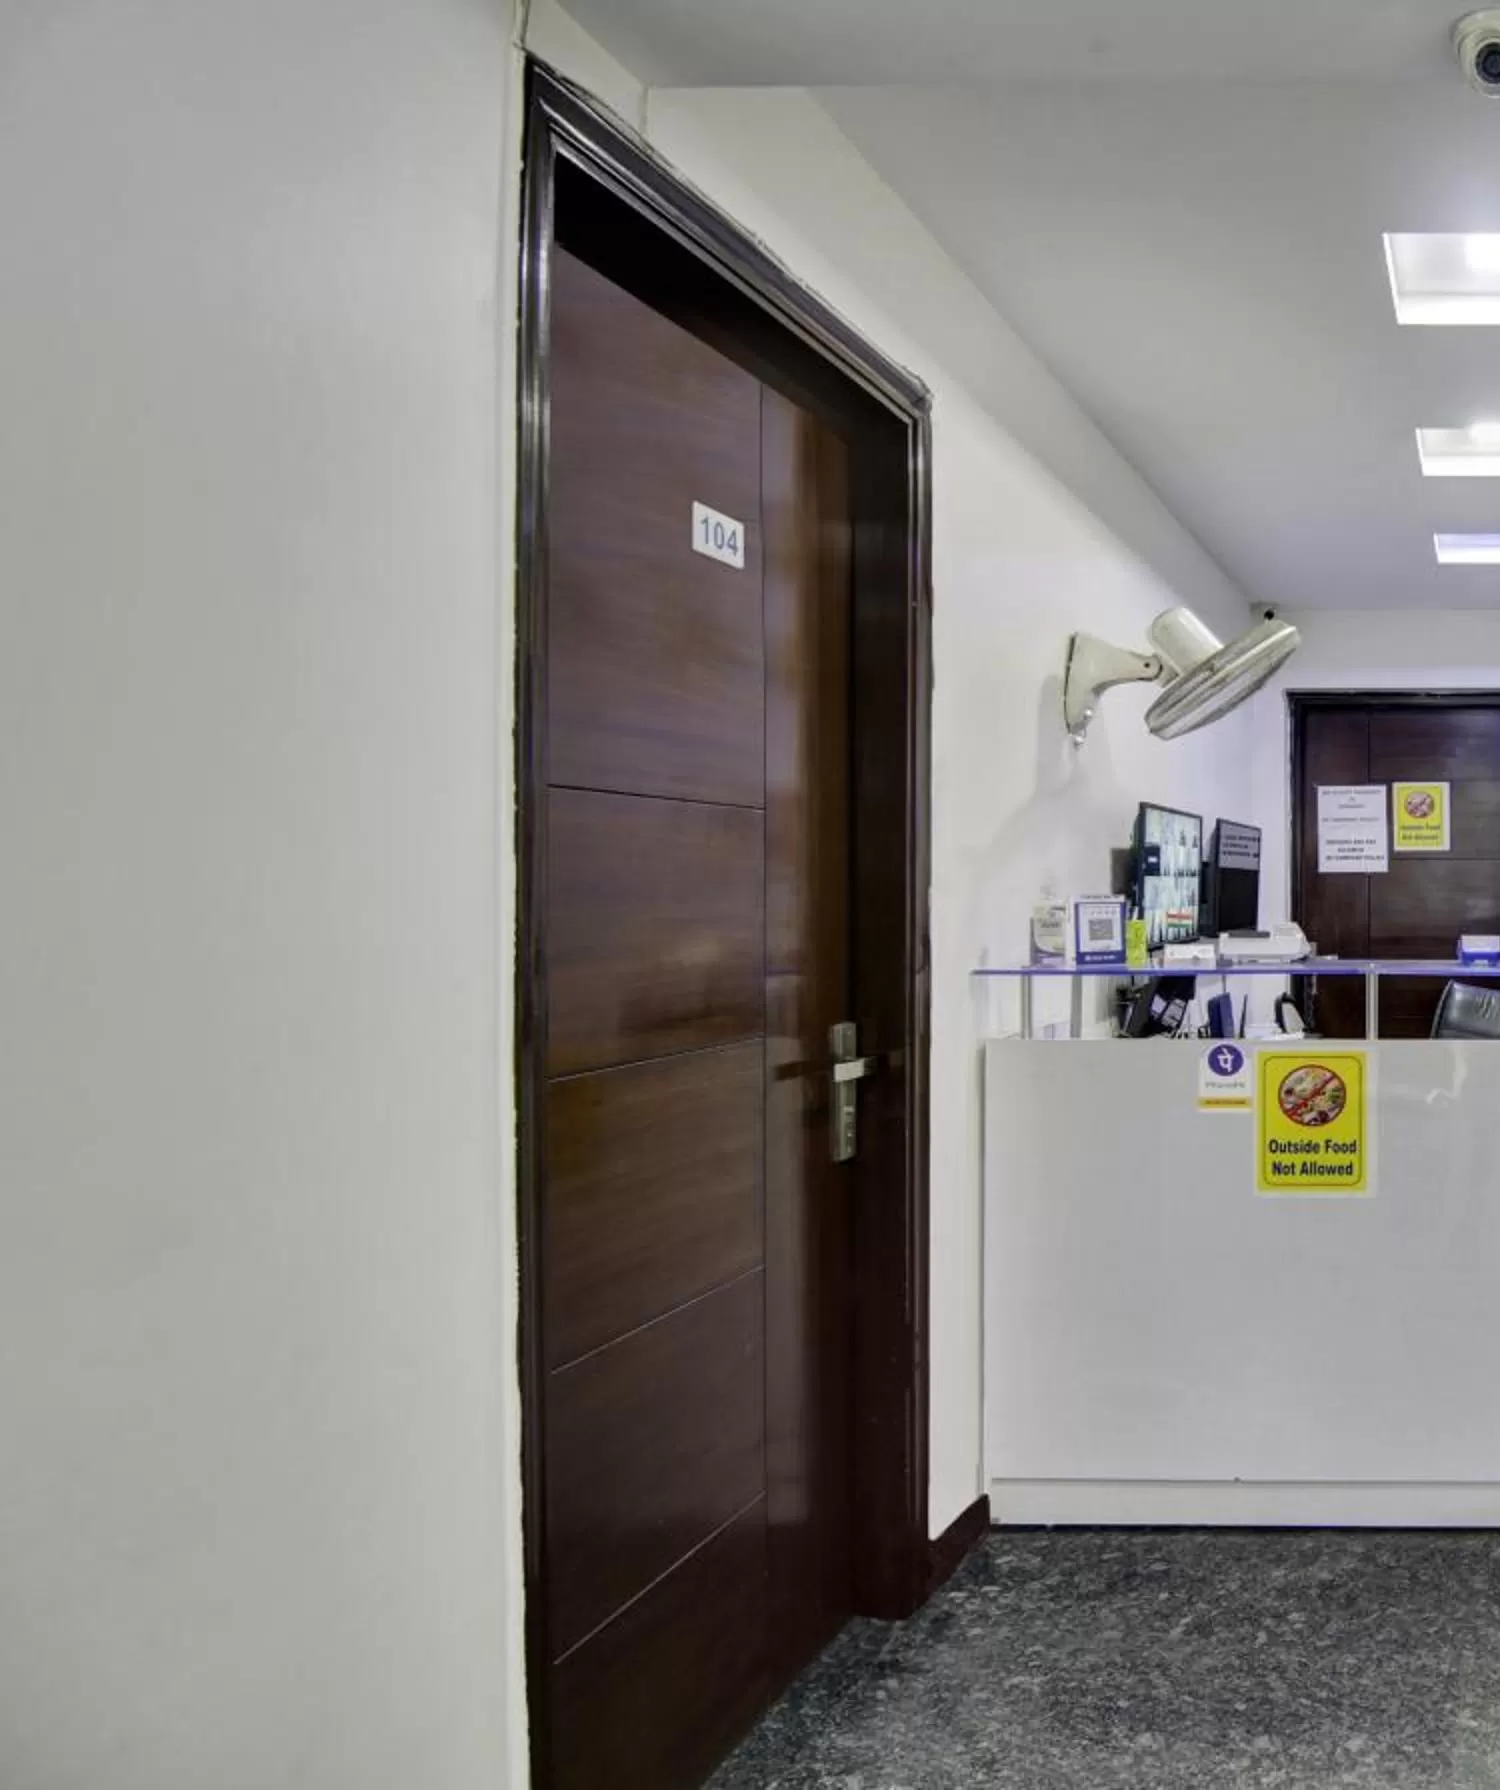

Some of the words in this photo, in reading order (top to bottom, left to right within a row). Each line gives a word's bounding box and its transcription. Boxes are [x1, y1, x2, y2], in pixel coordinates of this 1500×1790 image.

[700, 514, 738, 557] 104
[1269, 1139, 1321, 1154] Outside
[1324, 1139, 1357, 1154] Food
[1272, 1161, 1295, 1176] Not
[1300, 1161, 1353, 1176] Allowed
